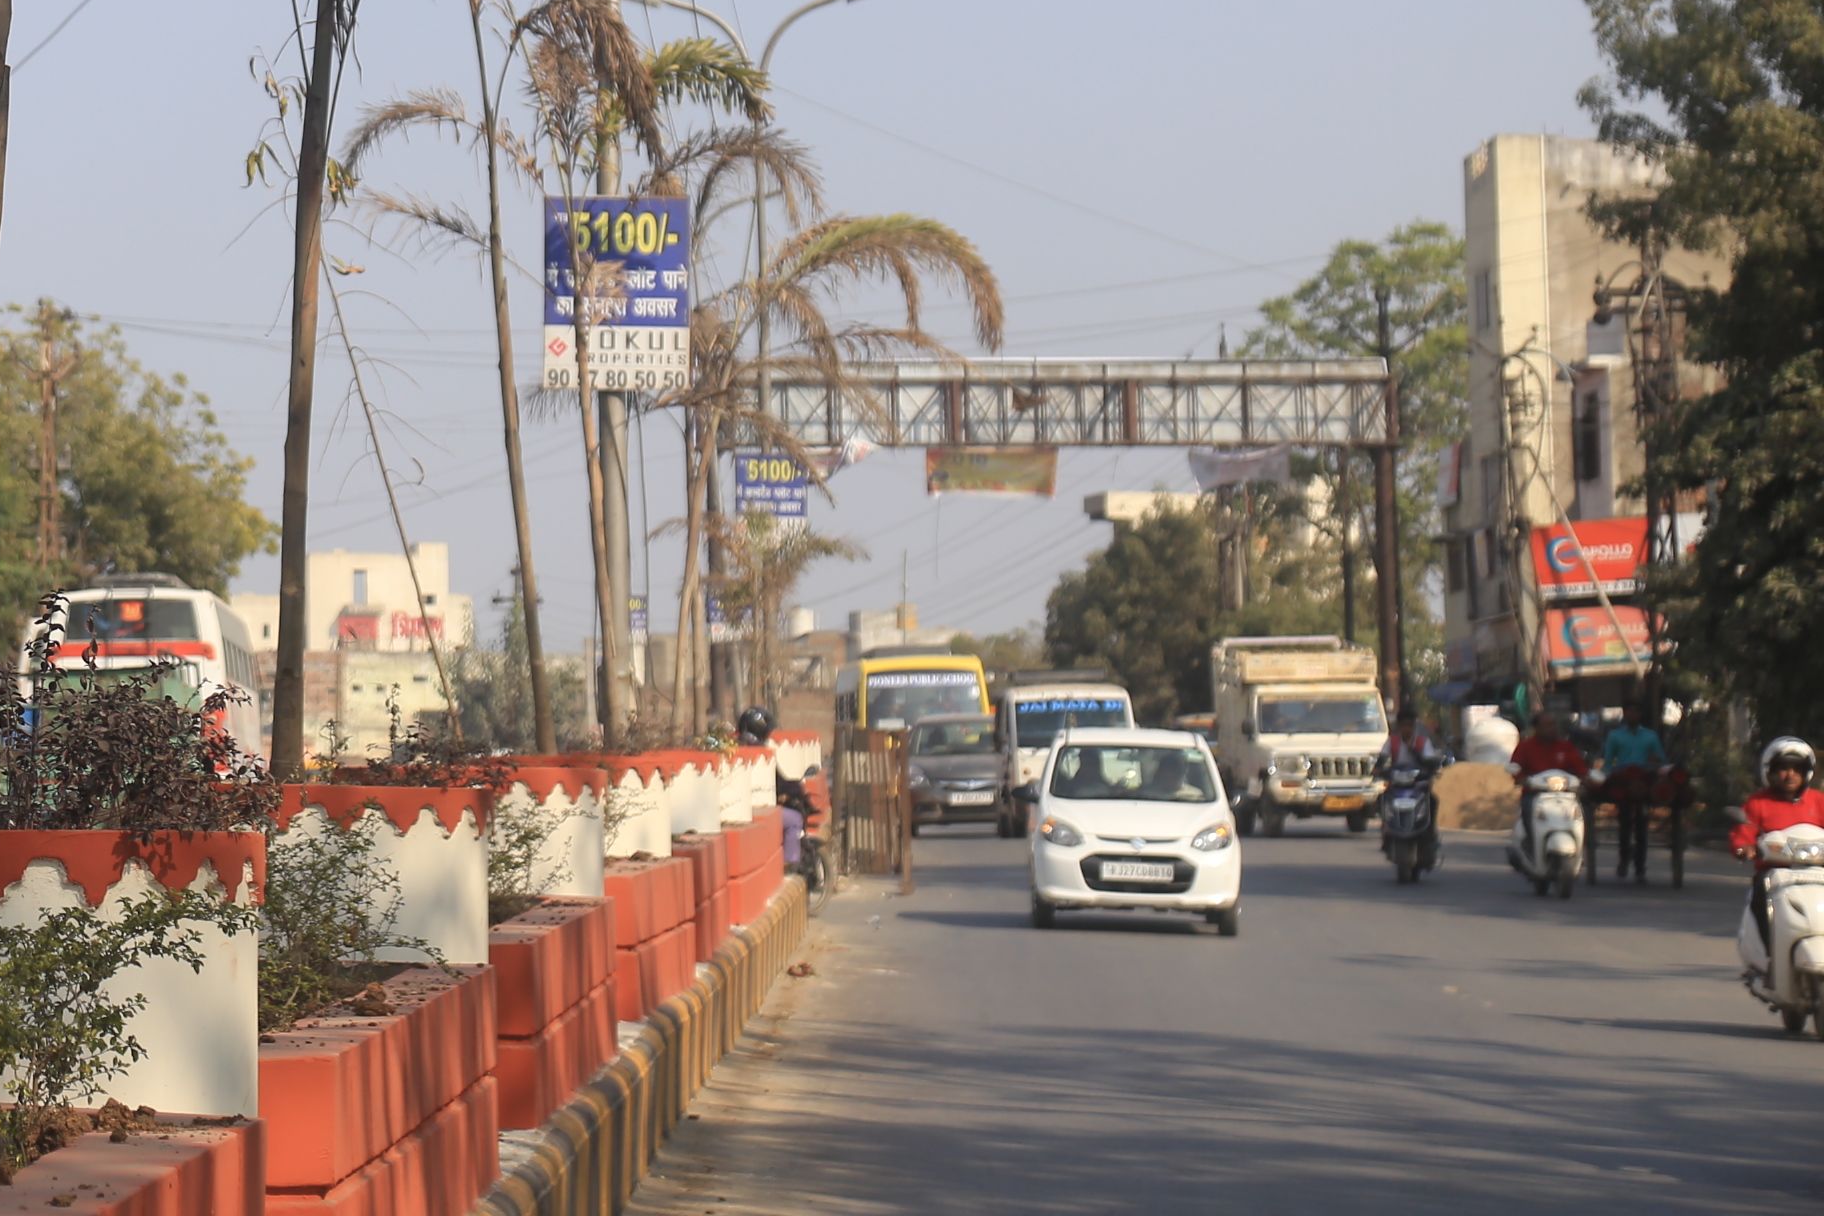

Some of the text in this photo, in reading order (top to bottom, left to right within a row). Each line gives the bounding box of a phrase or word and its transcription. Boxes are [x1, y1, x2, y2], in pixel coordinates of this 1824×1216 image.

[573, 211, 679, 255] 5100/-
[662, 264, 688, 290] पाने
[634, 298, 678, 318] अवसर
[592, 329, 687, 351] OKUL
[585, 352, 687, 365] ROPERTIES
[547, 369, 571, 387] 90
[606, 370, 628, 388] 80
[635, 370, 657, 388] 50
[663, 370, 687, 388] 50
